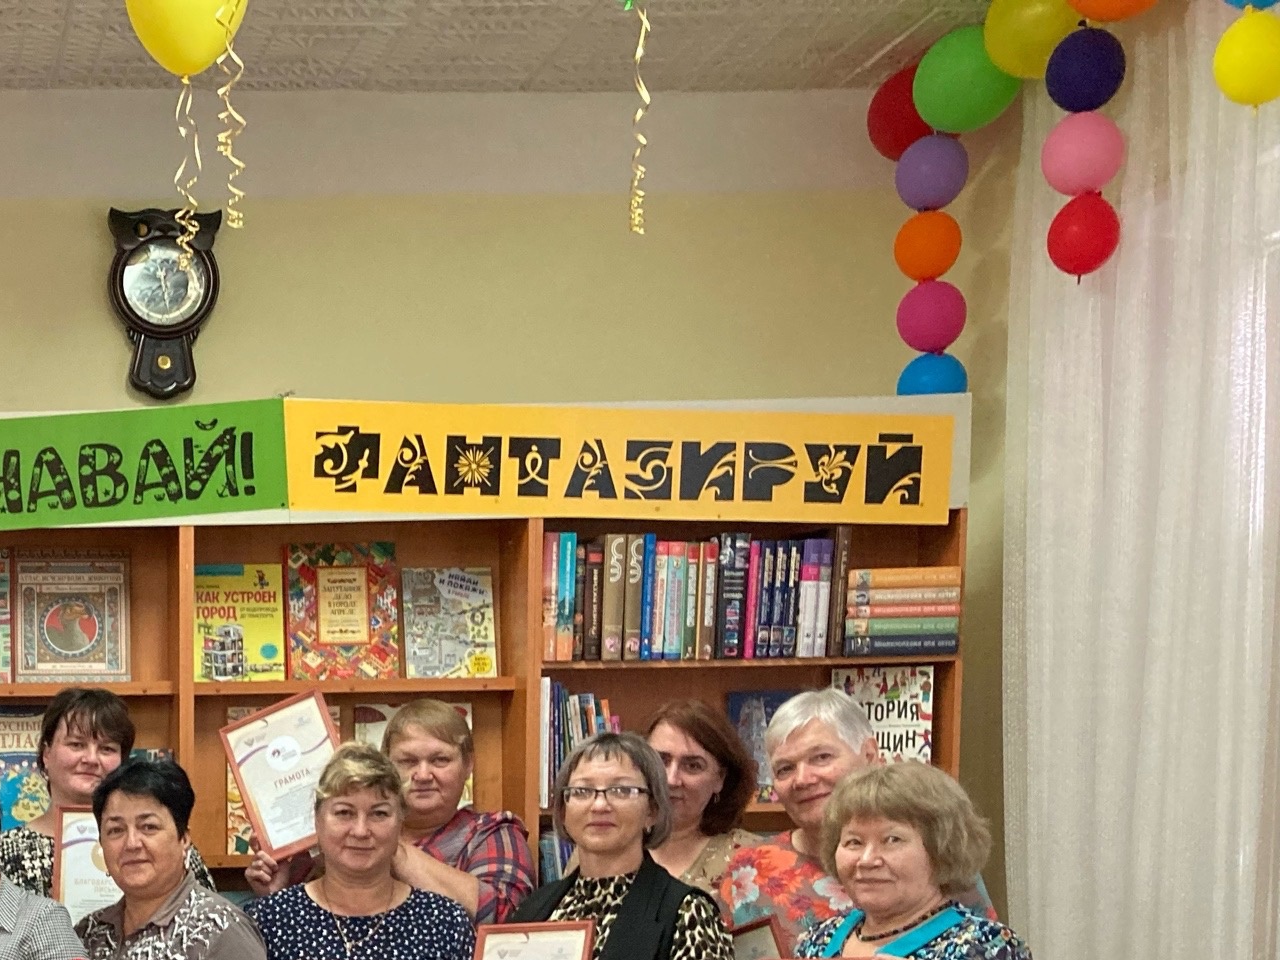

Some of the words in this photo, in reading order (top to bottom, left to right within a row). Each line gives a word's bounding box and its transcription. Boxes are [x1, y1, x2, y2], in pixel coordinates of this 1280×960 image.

[313, 425, 923, 505] ФАНТАЗИРУЙ
[196, 591, 220, 603] КАК
[223, 590, 277, 604] УСТРОЕН
[196, 605, 238, 622] ГОРОД
[859, 700, 920, 722] ТОРИЯ
[872, 730, 917, 753] ЩИН
[273, 767, 311, 790] ГРАМОТА
